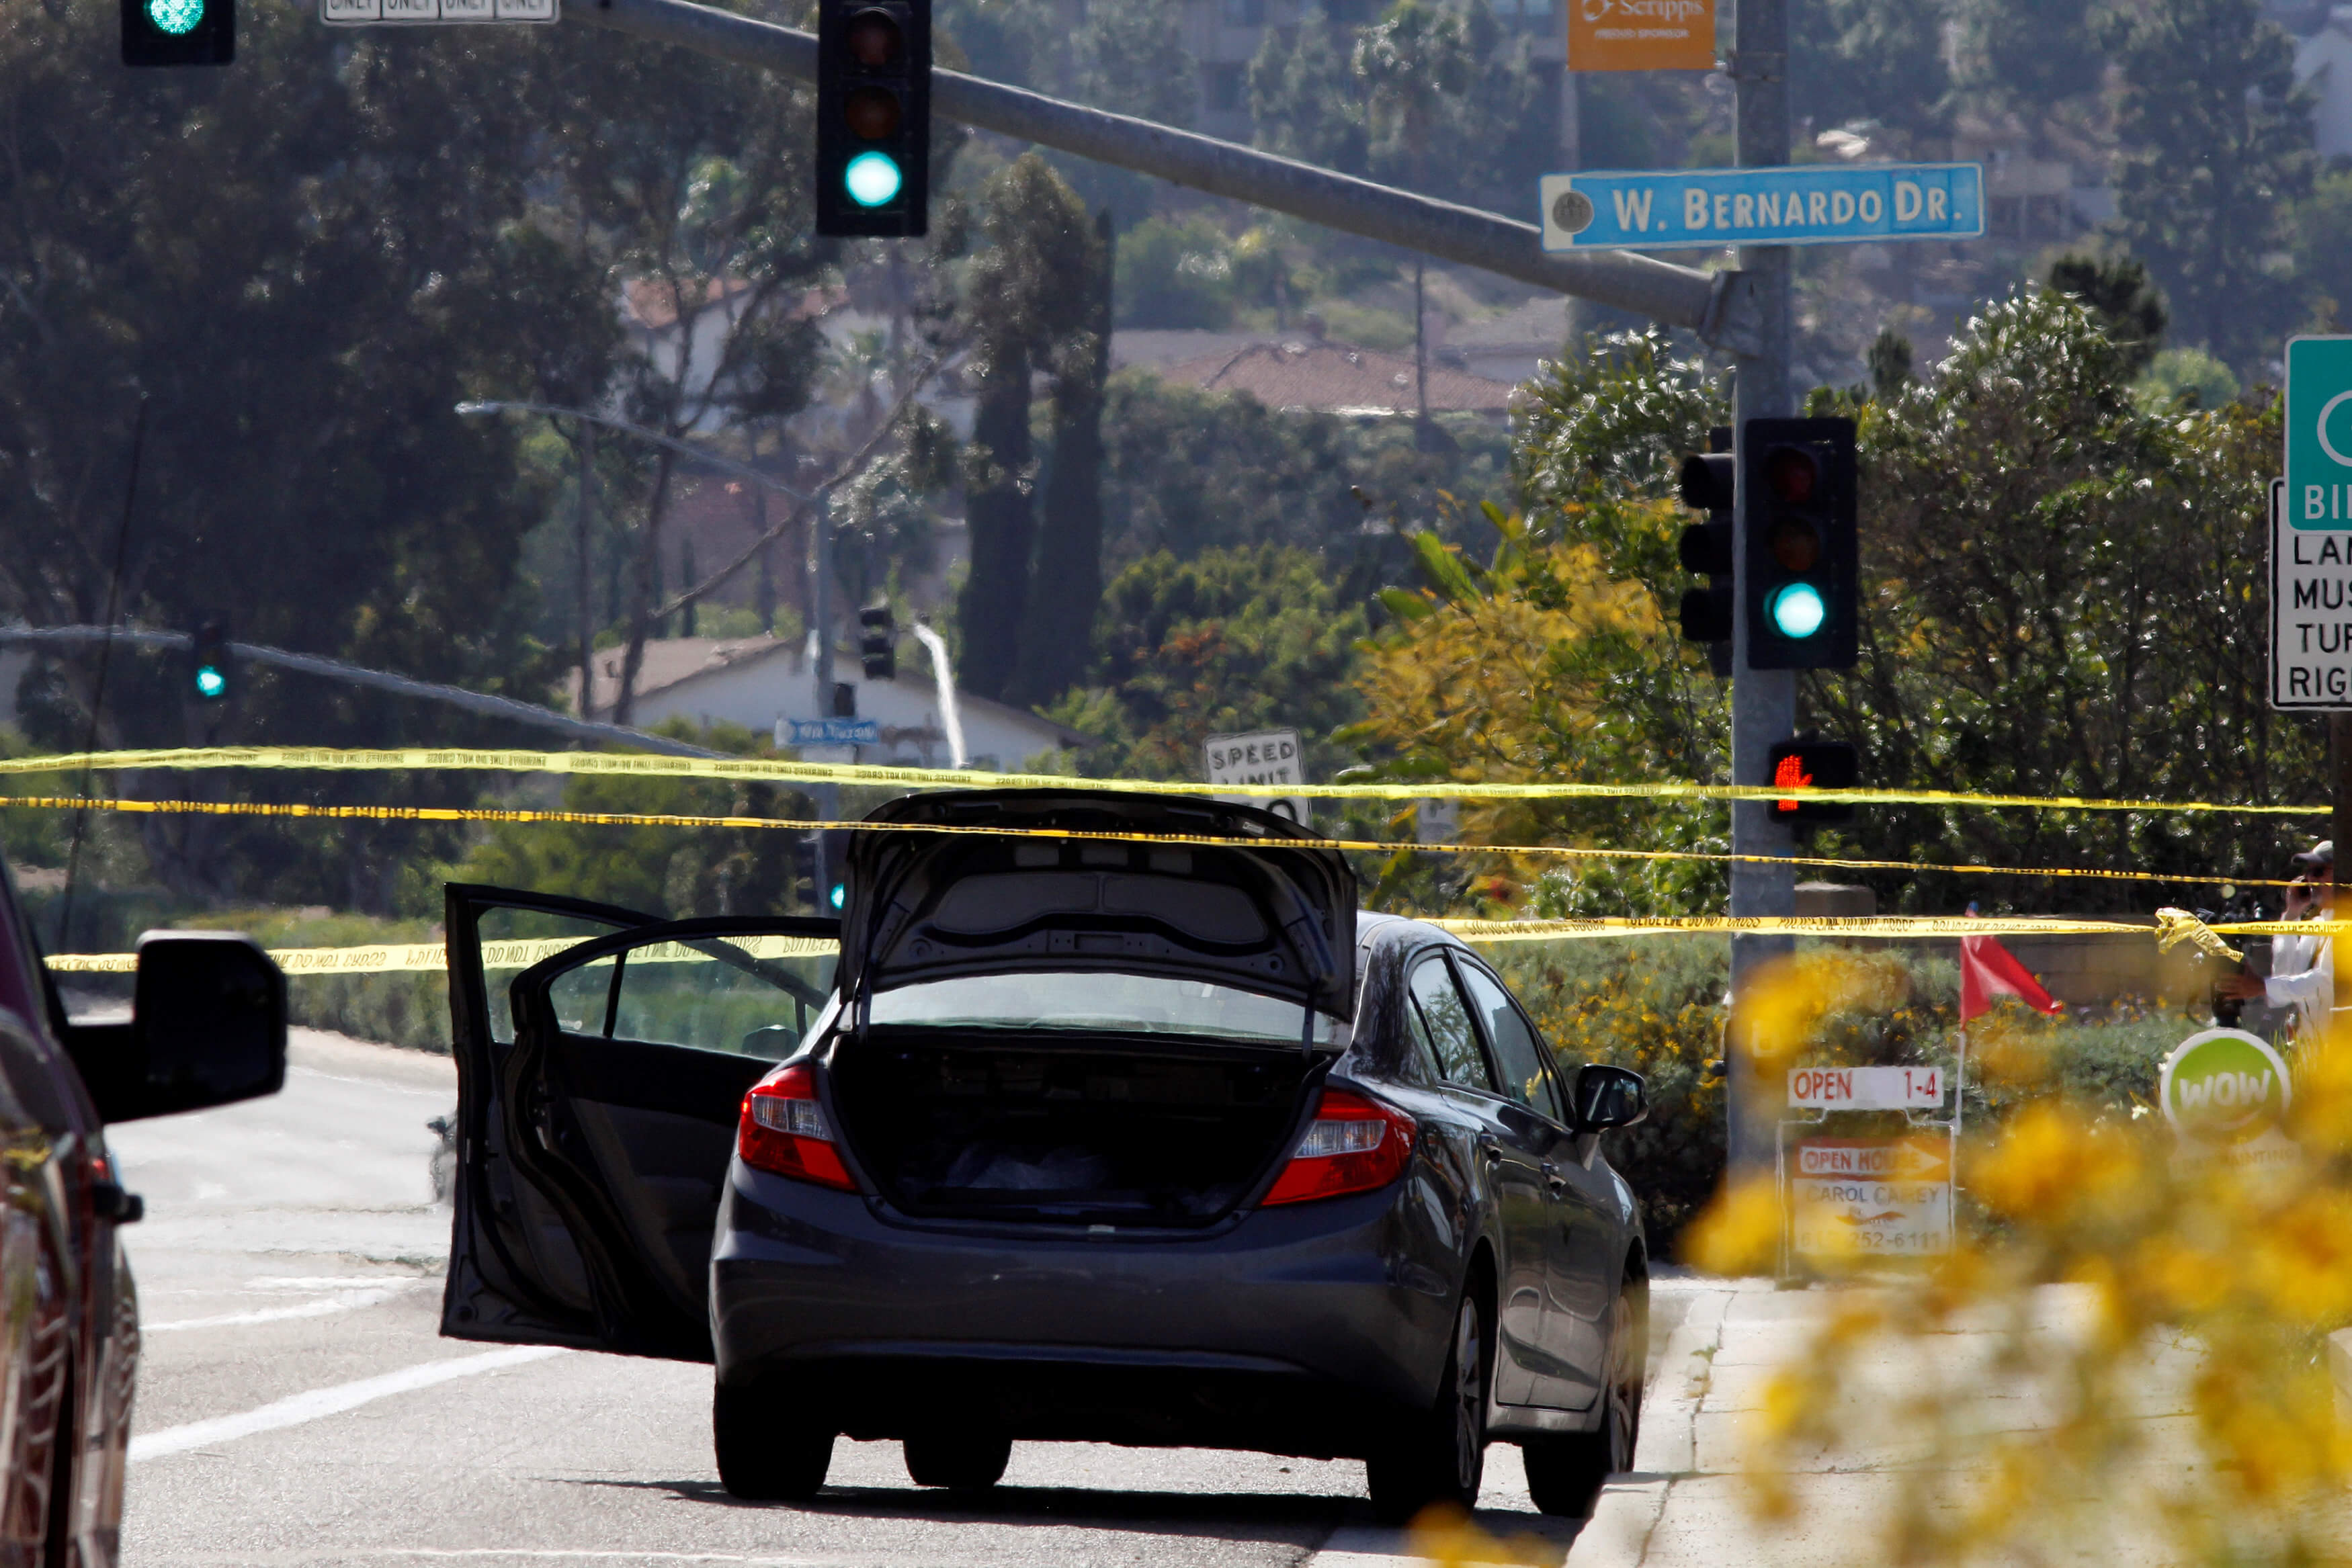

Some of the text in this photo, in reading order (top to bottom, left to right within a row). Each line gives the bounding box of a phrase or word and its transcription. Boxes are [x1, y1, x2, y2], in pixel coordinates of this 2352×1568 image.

[1620, 0, 1705, 21] Scripps
[1613, 180, 1962, 232] W. BERNARDO DR.
[2304, 484, 2352, 519] BI
[2294, 535, 2352, 565] LA
[2294, 578, 2352, 610] MU
[2289, 667, 2352, 697] RIG
[1211, 742, 1295, 770] SPEED
[1794, 1070, 1937, 1100] OPEN 1-4
[2179, 1069, 2272, 1110] WOW
[1805, 1151, 1852, 1171] OPEN
[1806, 1186, 1867, 1203] CAROL
